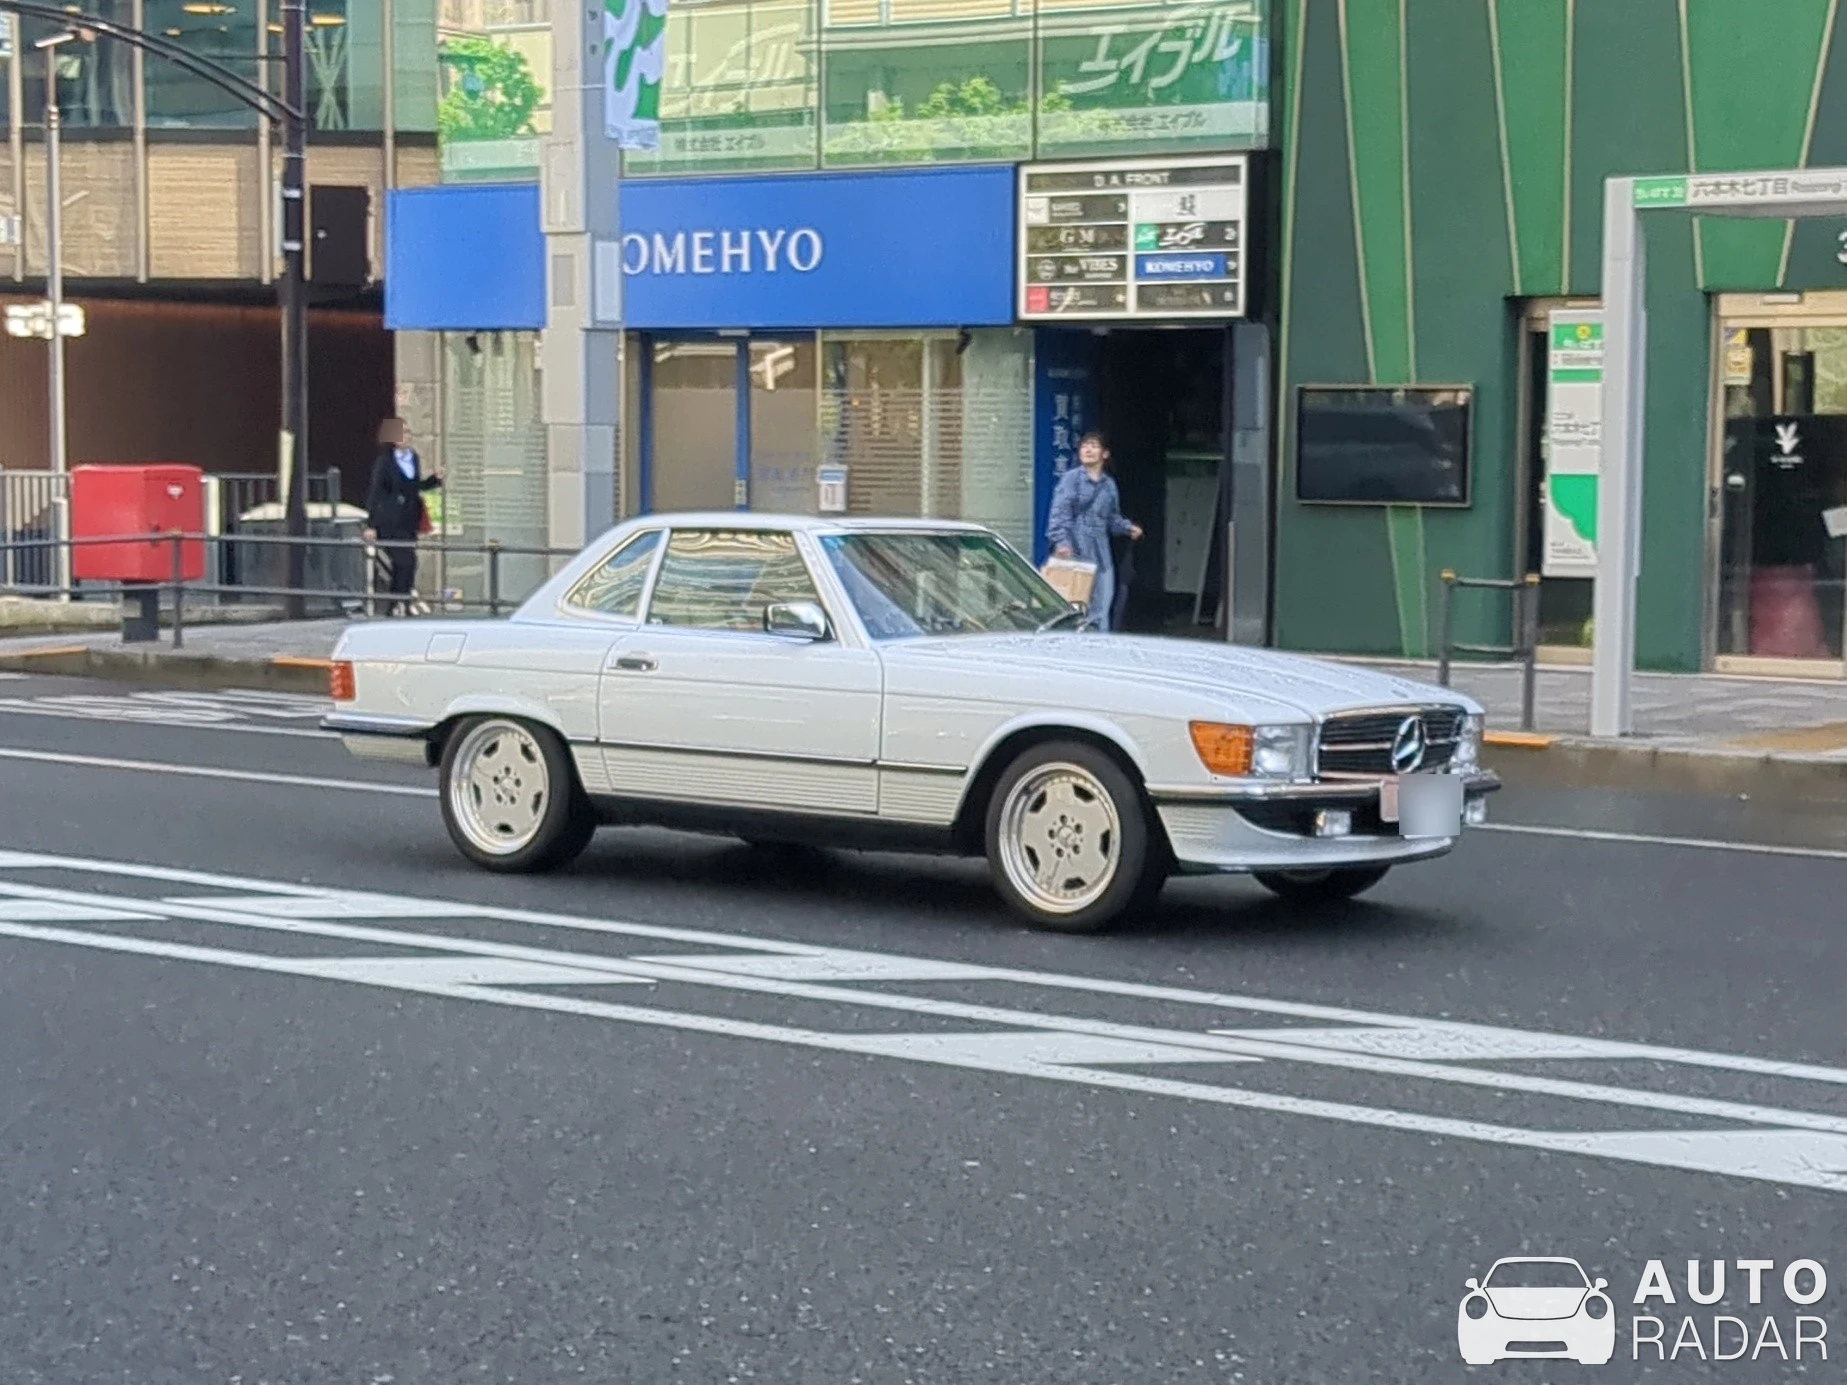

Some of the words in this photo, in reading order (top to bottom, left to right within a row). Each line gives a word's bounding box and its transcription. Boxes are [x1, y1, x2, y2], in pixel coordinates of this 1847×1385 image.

[1058, 8, 1262, 95] エイブル
[1692, 177, 1789, 198] 六本木七丁目
